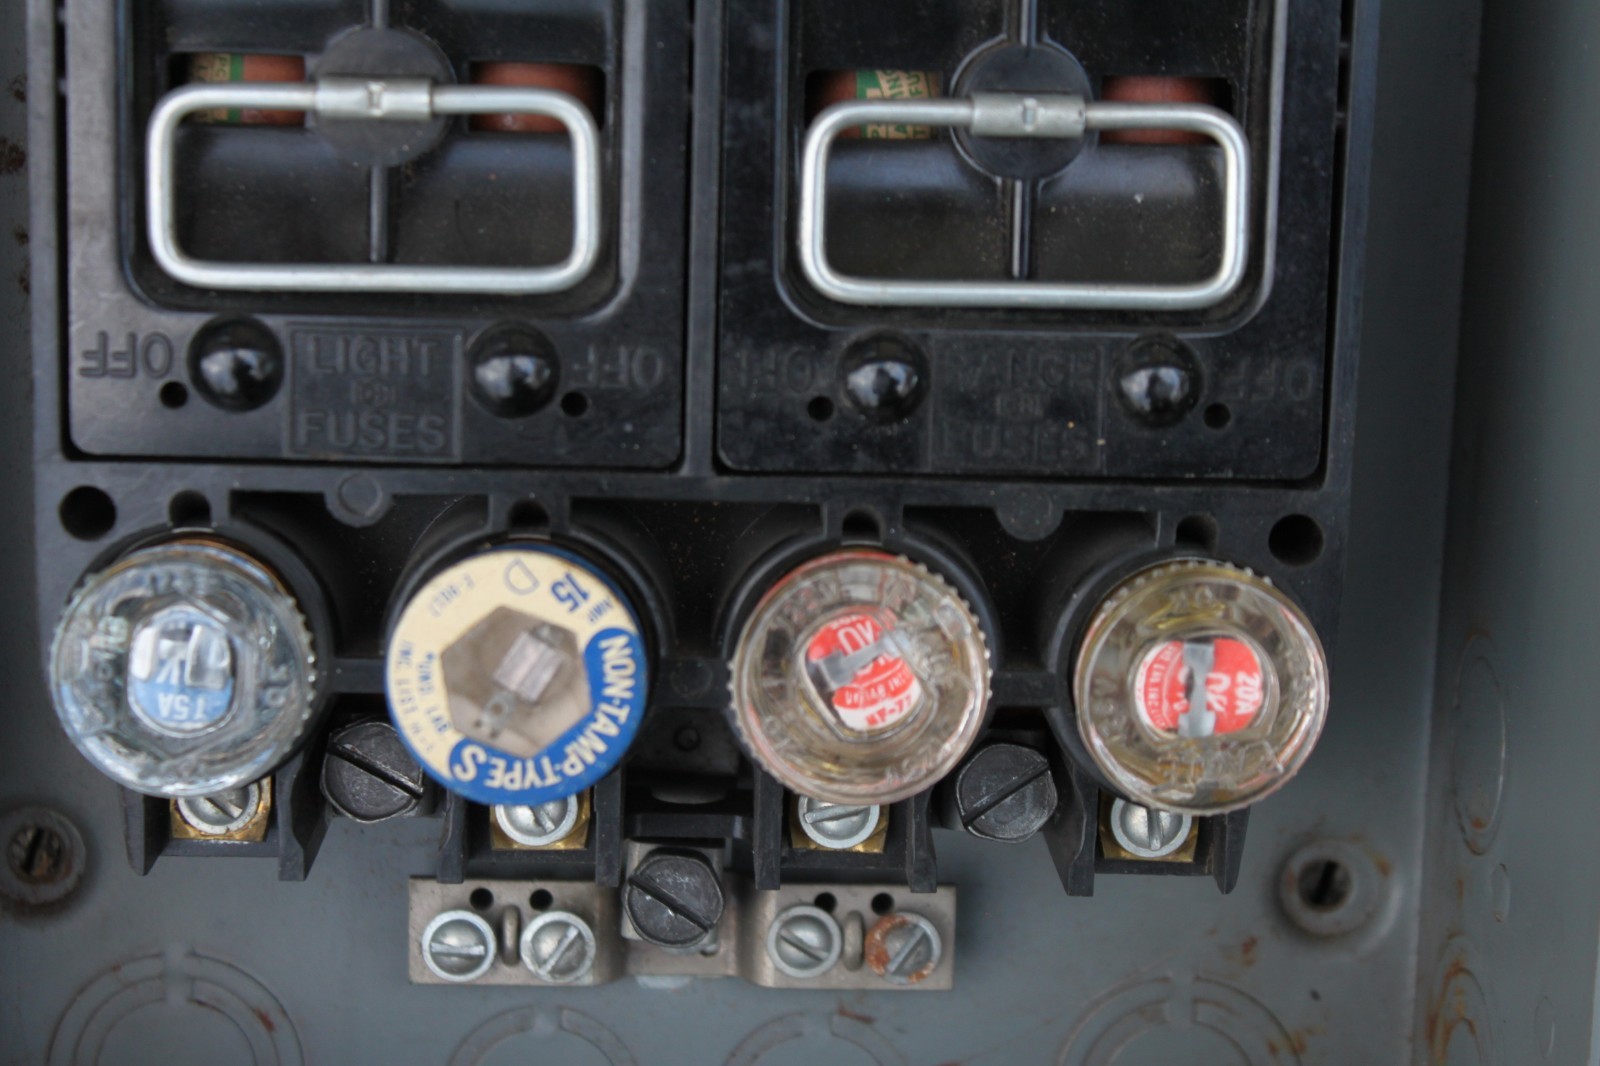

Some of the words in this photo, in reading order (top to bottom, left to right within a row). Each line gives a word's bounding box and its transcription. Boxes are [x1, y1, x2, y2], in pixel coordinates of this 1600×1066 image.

[79, 330, 175, 379] OFF
[304, 335, 441, 378] LIGHT
[572, 342, 664, 391] OFF
[297, 412, 447, 452] FUSES
[502, 558, 540, 596] D
[549, 571, 591, 613] 15
[1234, 670, 1261, 716] 20A
